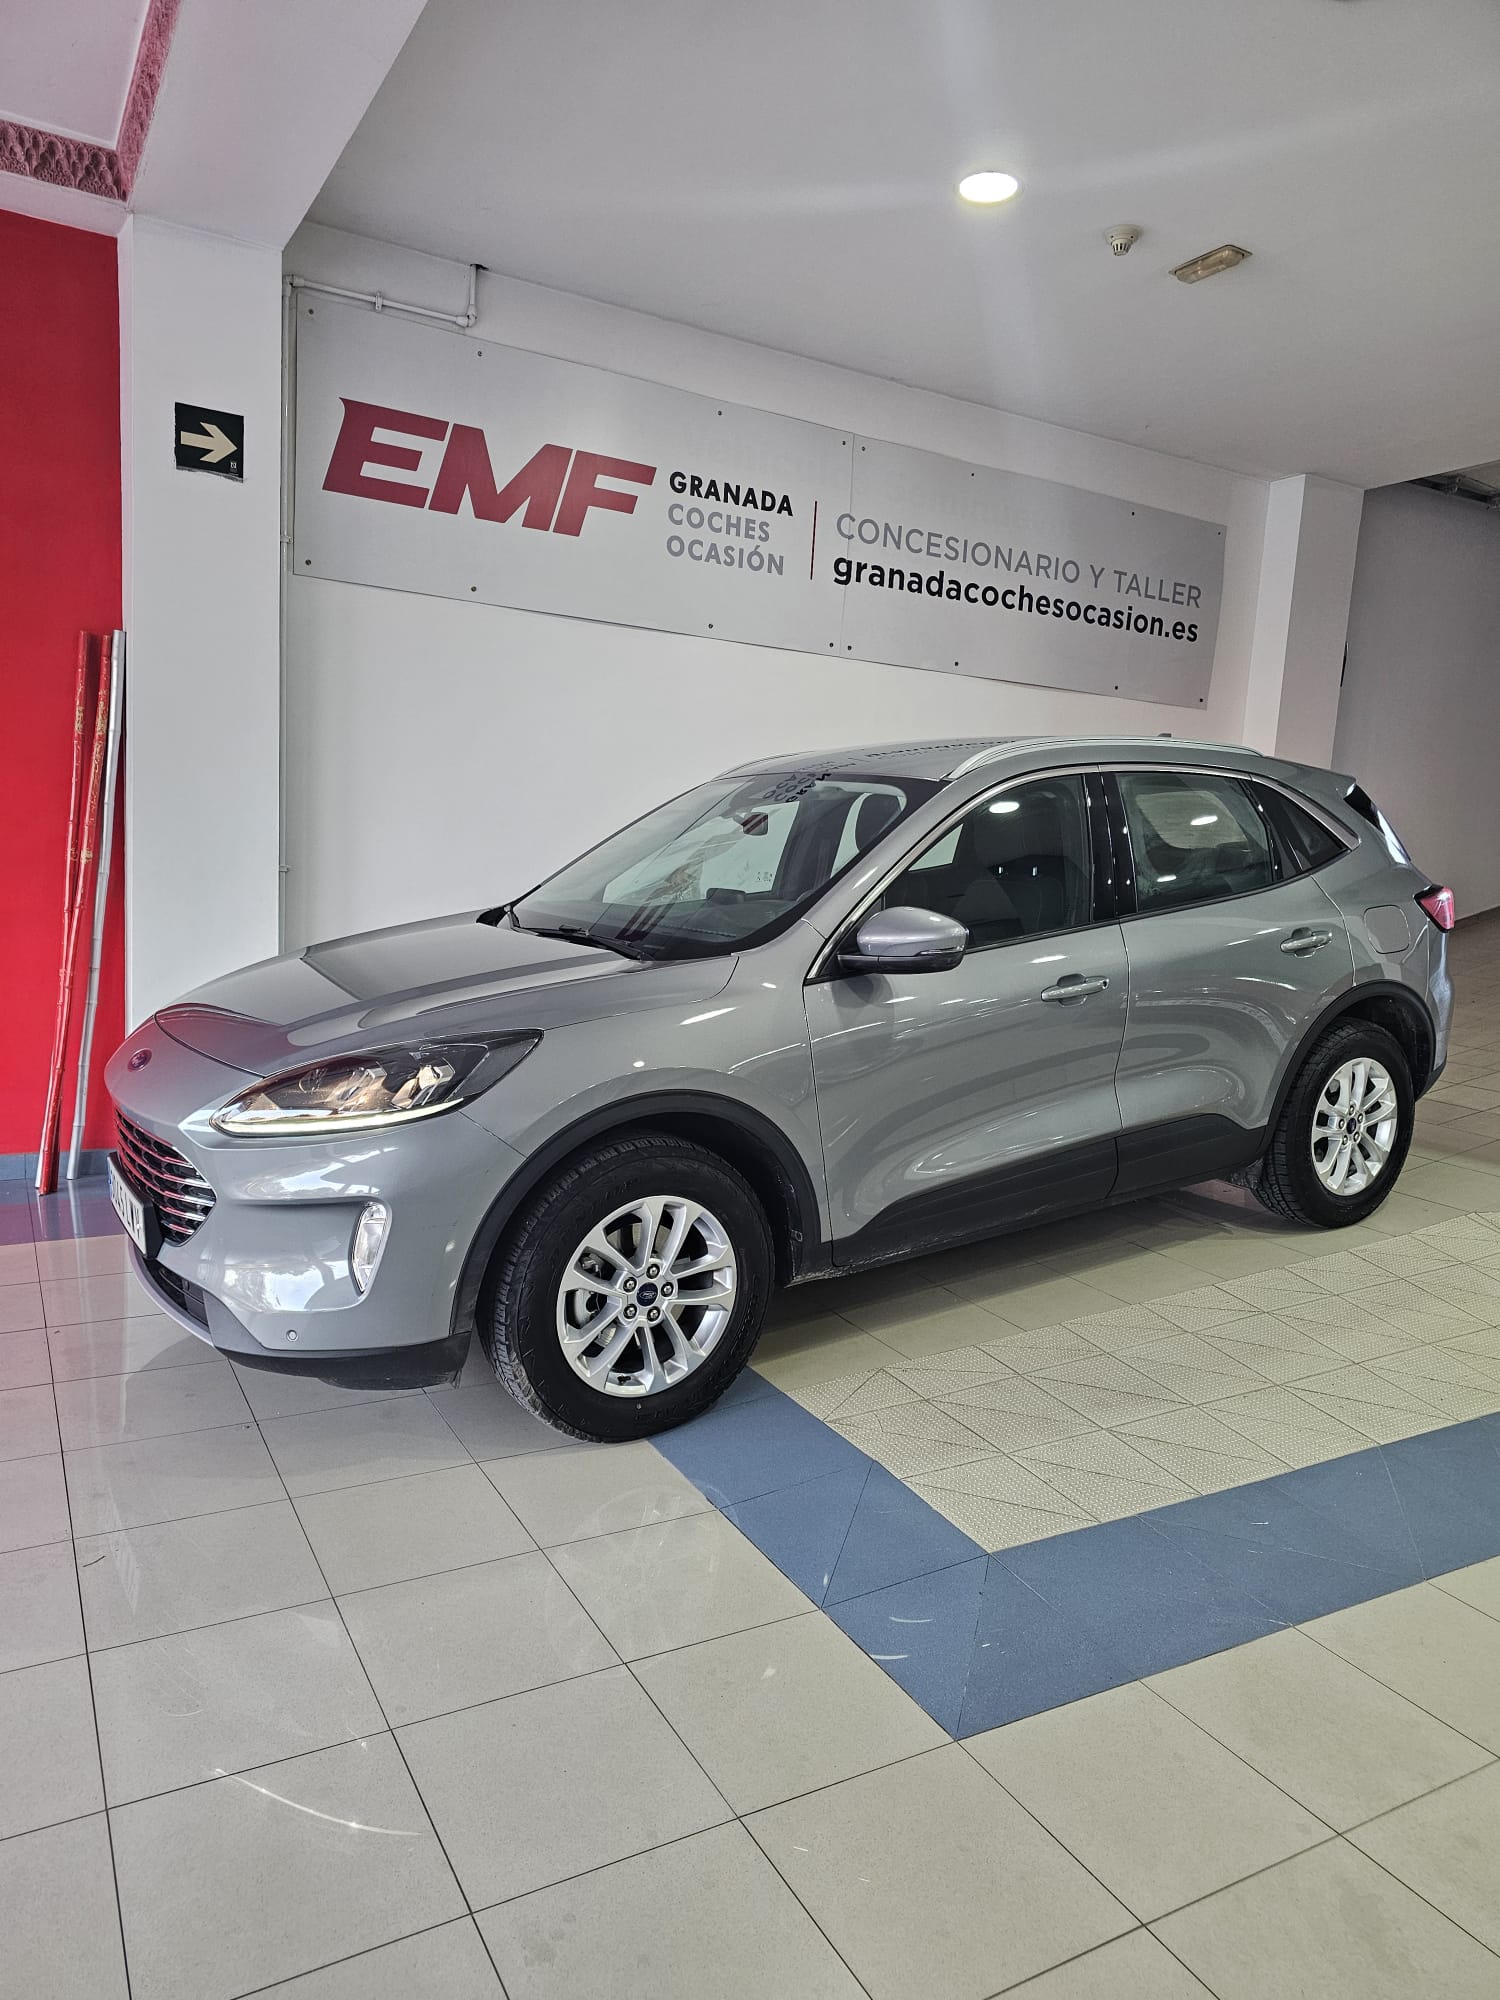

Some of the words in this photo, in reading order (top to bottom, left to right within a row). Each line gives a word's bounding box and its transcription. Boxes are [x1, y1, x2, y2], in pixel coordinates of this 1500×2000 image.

[322, 397, 657, 537] EMF
[669, 470, 794, 518] GRANADA
[666, 535, 785, 576] OCASIÓN
[667, 503, 770, 543] COCHES
[836, 513, 1081, 584] CONCESIONARIO
[1089, 564, 1106, 589] Y
[1113, 569, 1202, 609] TALLER
[833, 556, 1199, 643] granadacochesocasion.es
